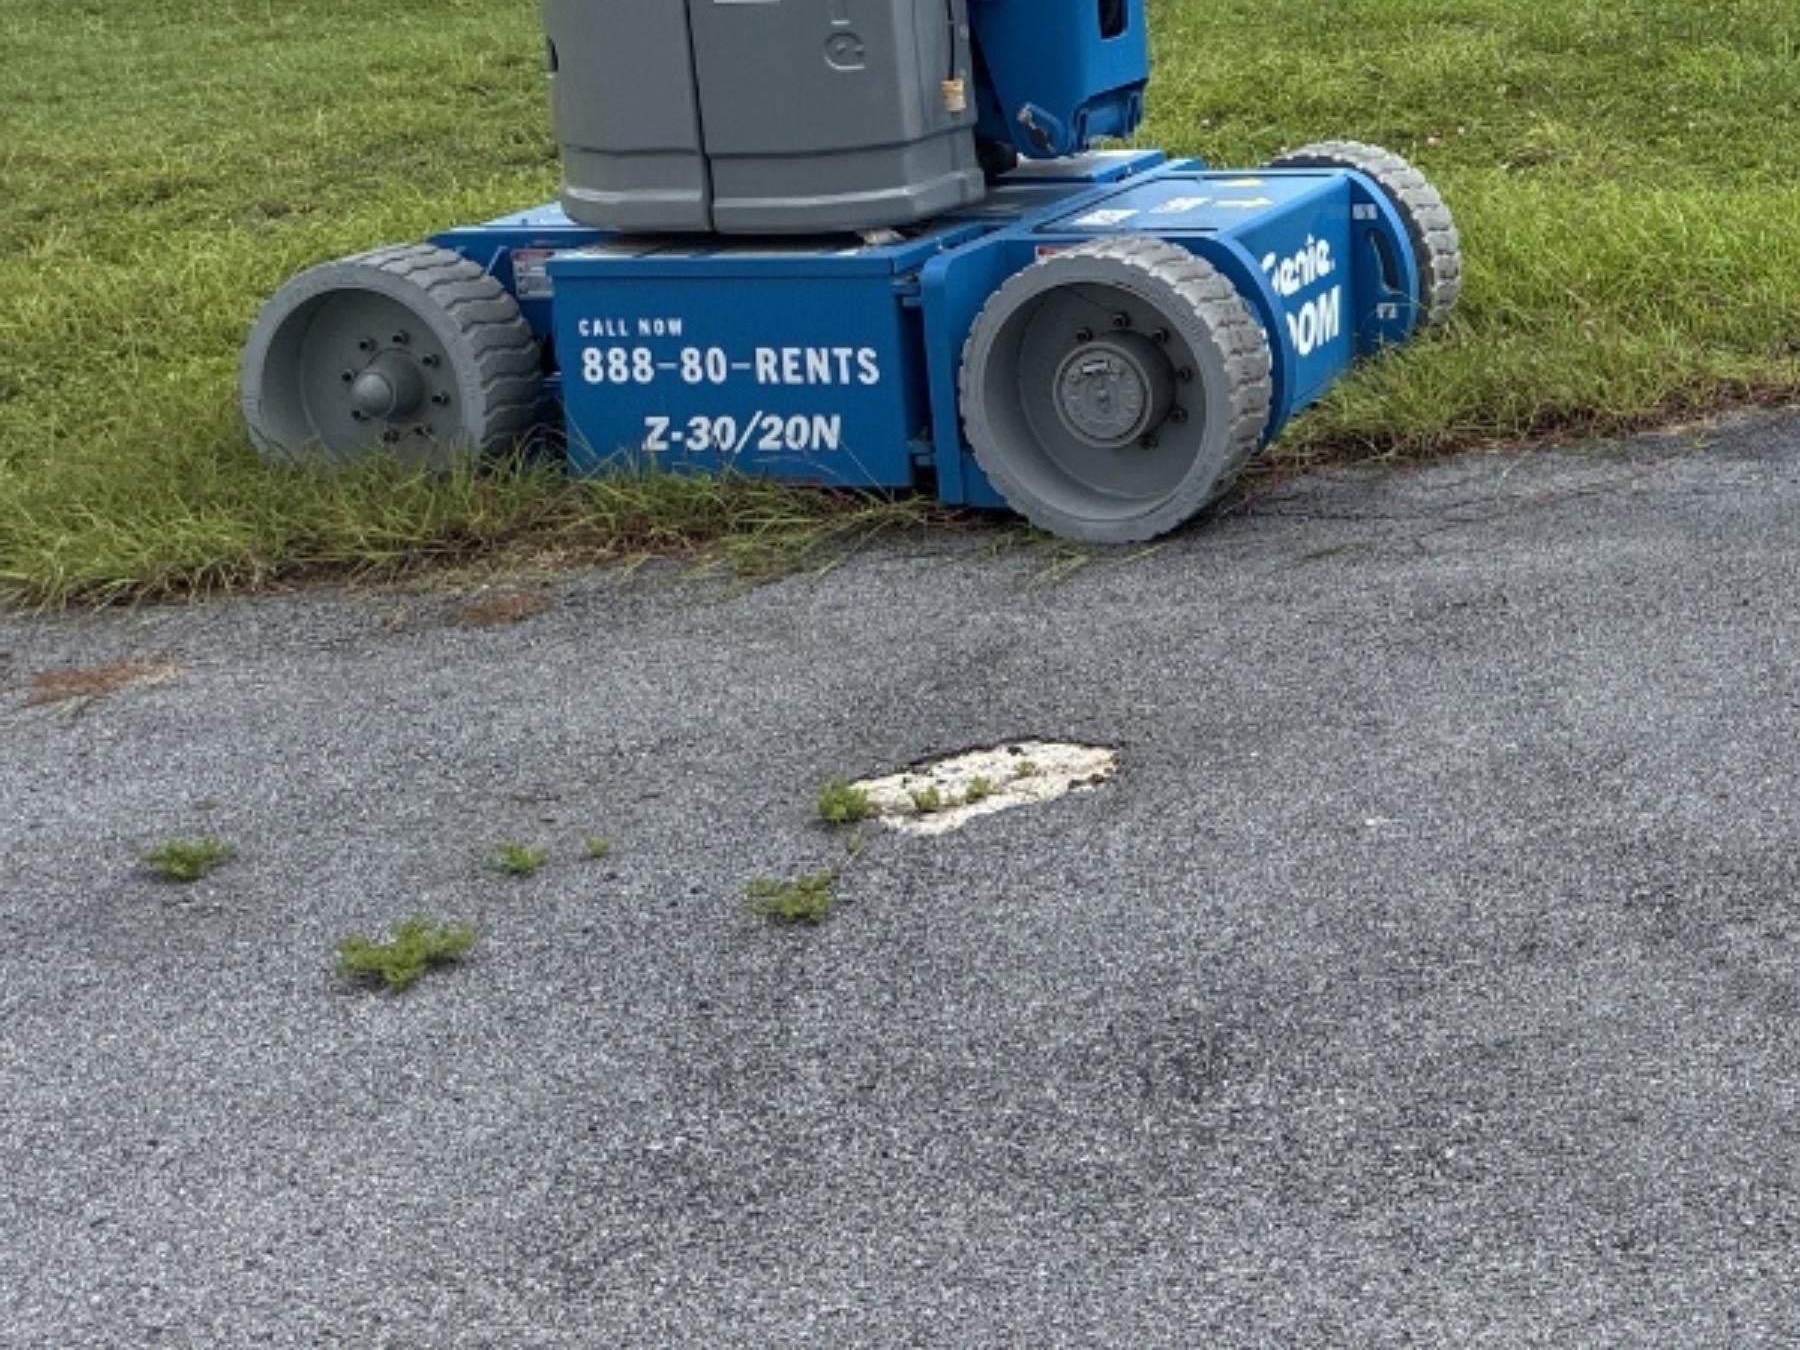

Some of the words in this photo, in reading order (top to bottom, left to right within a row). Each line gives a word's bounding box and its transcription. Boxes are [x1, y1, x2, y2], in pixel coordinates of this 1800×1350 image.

[578, 318, 630, 336] CALL
[638, 317, 682, 336] NOW
[582, 346, 880, 385] 888-80-RENTS
[642, 410, 841, 455] Z-30/20N
